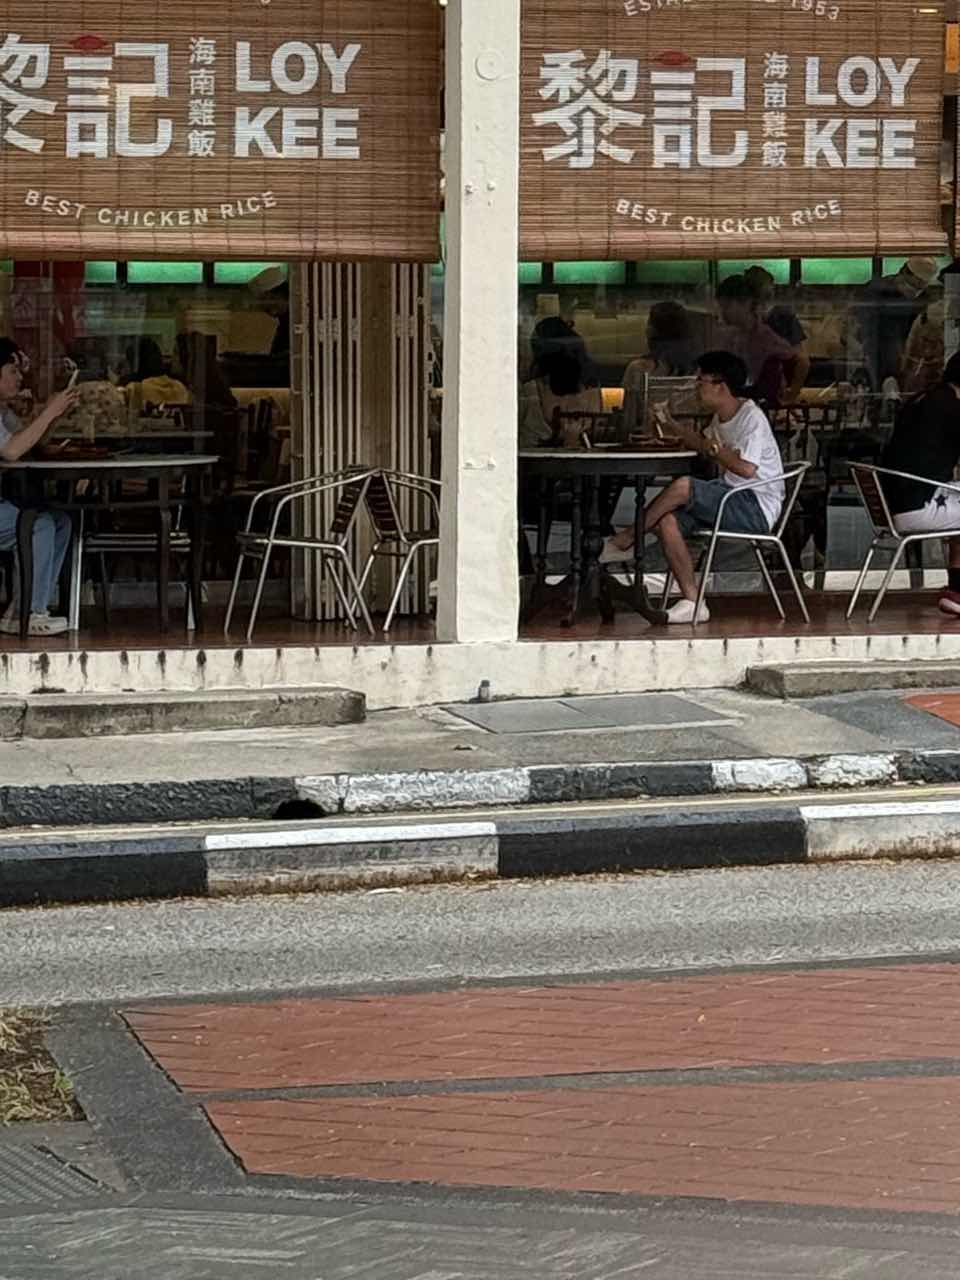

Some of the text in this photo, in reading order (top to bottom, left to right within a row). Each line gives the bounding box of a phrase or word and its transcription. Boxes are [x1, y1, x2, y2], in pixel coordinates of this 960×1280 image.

[235, 40, 361, 94] LOY
[805, 56, 920, 107] LOY
[234, 107, 360, 159] KEE
[532, 49, 749, 168] 黎記
[804, 119, 917, 168] KEE
[26, 190, 277, 227] BEST CHICKEN RICE
[616, 199, 841, 235] BEST CHICKEN RICE
